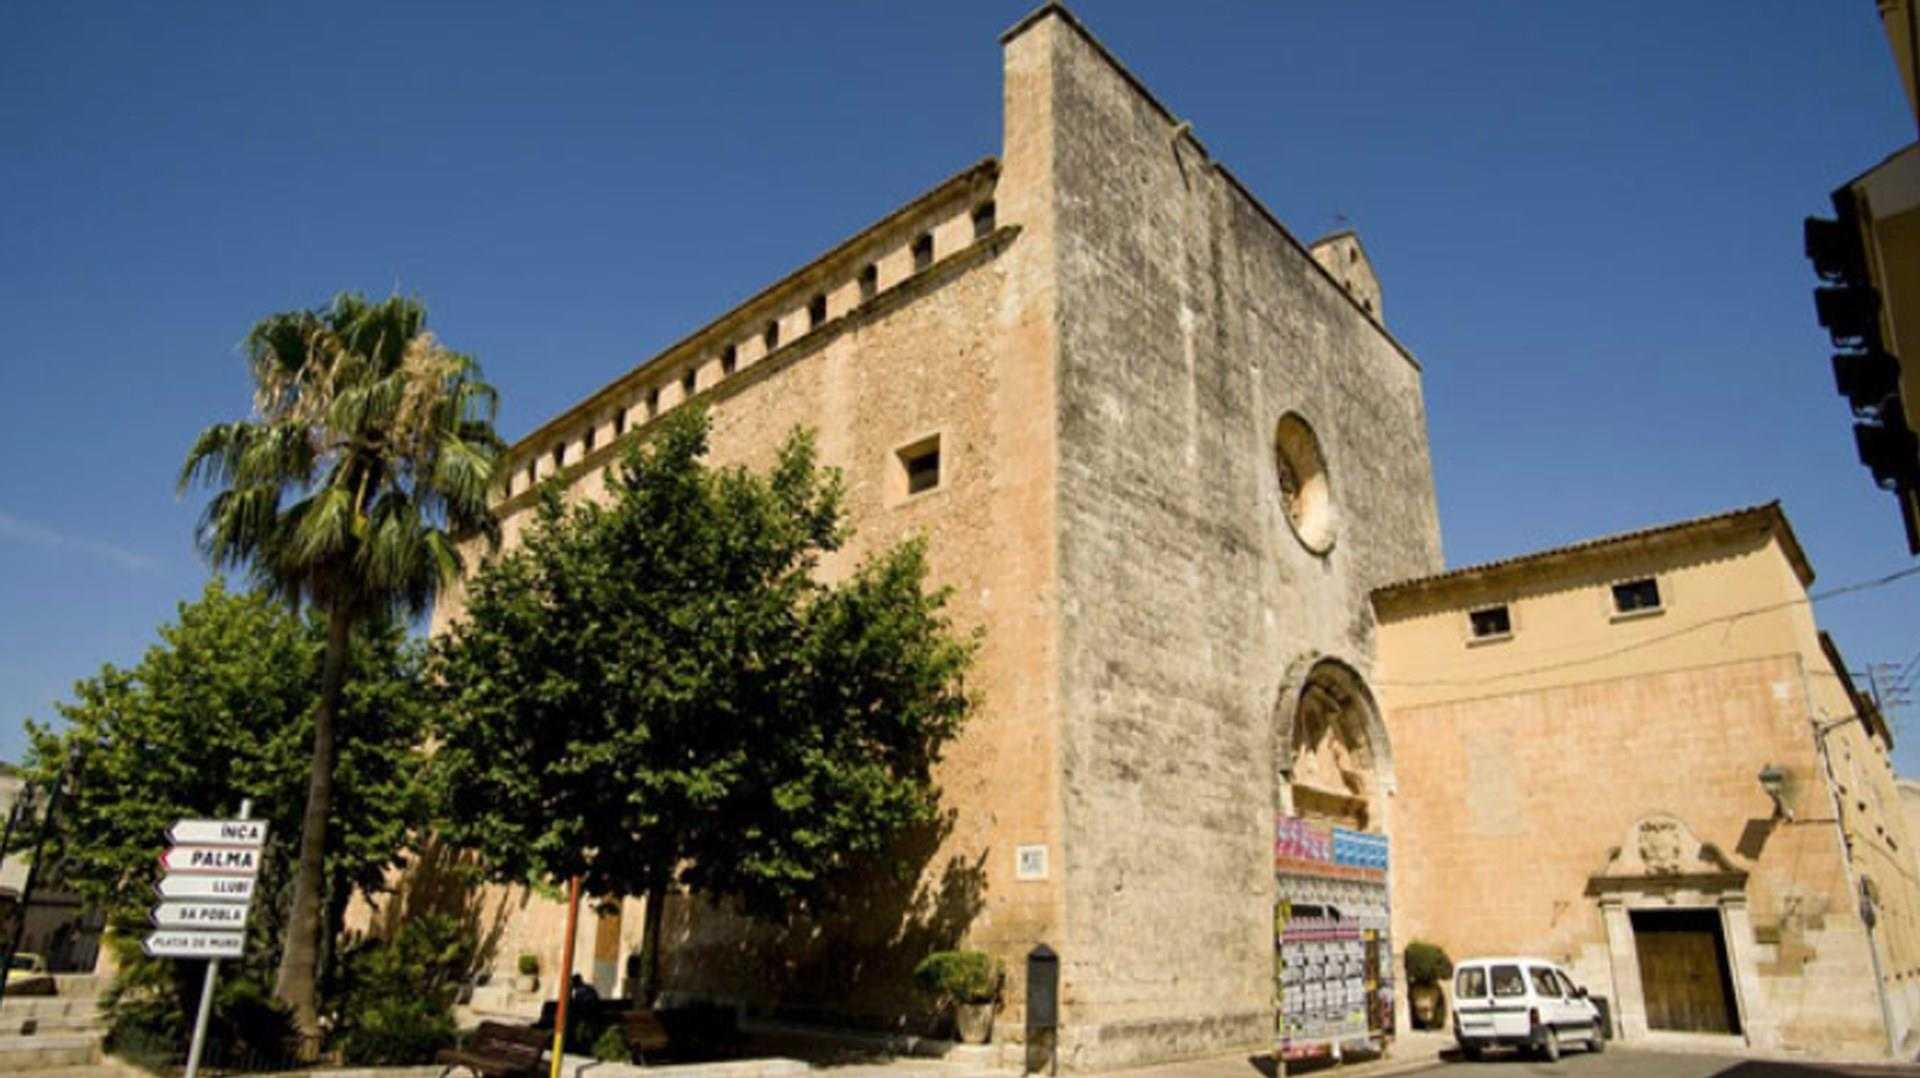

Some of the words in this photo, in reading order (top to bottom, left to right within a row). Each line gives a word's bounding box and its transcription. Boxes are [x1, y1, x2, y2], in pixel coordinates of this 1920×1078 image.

[221, 823, 258, 839] INCA
[191, 850, 253, 867] PALMA
[199, 907, 241, 920] POBLA
